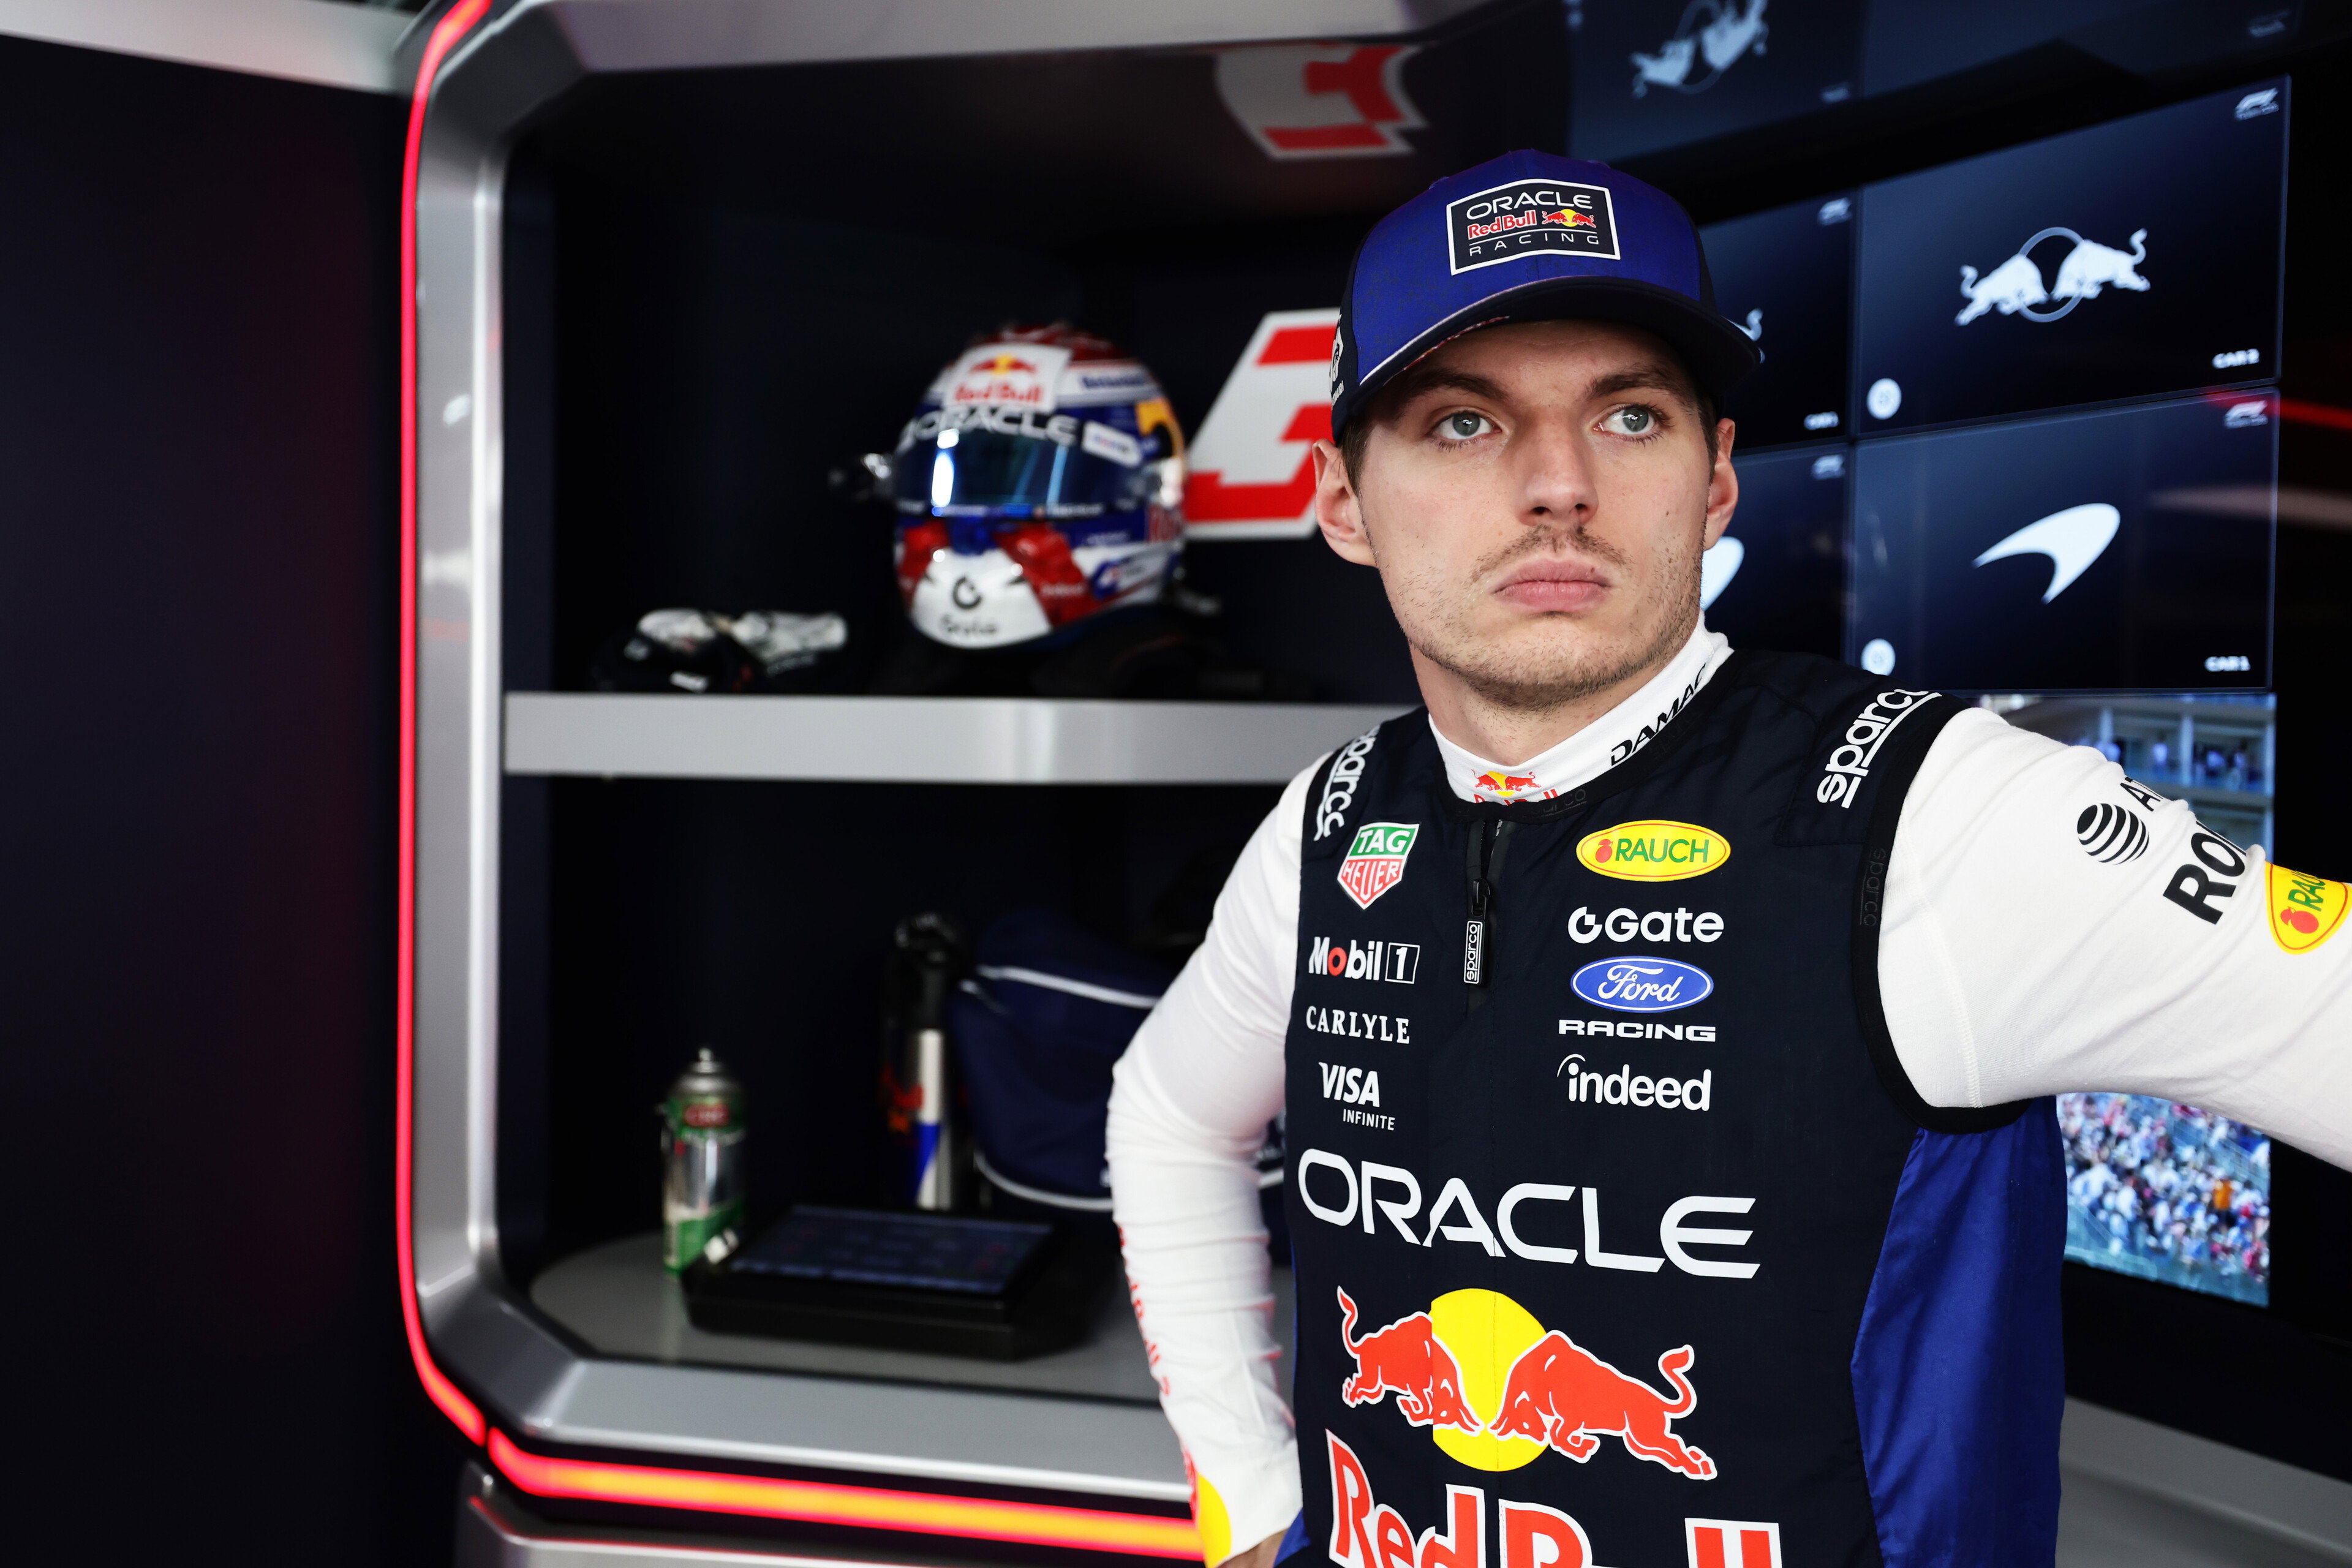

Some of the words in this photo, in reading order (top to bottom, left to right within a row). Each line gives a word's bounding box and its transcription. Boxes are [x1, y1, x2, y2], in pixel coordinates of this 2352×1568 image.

[1466, 191, 1593, 220] ORACLE
[1468, 217, 1502, 240] Red
[1502, 209, 1537, 232] Bull
[1469, 233, 1599, 256] RACING
[1358, 829, 1411, 854] TAG
[1615, 838, 1709, 863] RAUCH
[1343, 861, 1400, 901] HEUER
[2162, 820, 2247, 925] RO
[1605, 907, 1724, 943] Gate
[1308, 937, 1383, 981] Mobil
[1396, 946, 1408, 980] 1
[1466, 924, 1480, 981] sparco
[1597, 964, 1684, 1002] Ford
[1306, 1005, 1410, 1044] CARLYLE
[1558, 1019, 1716, 1042] RACING
[1318, 1061, 1380, 1107] VISA
[1556, 1054, 1712, 1112] indeed
[1343, 1109, 1396, 1131] INFINITE
[1297, 1148, 1761, 1279] ORACLE
[1325, 1428, 1485, 1568] Red
